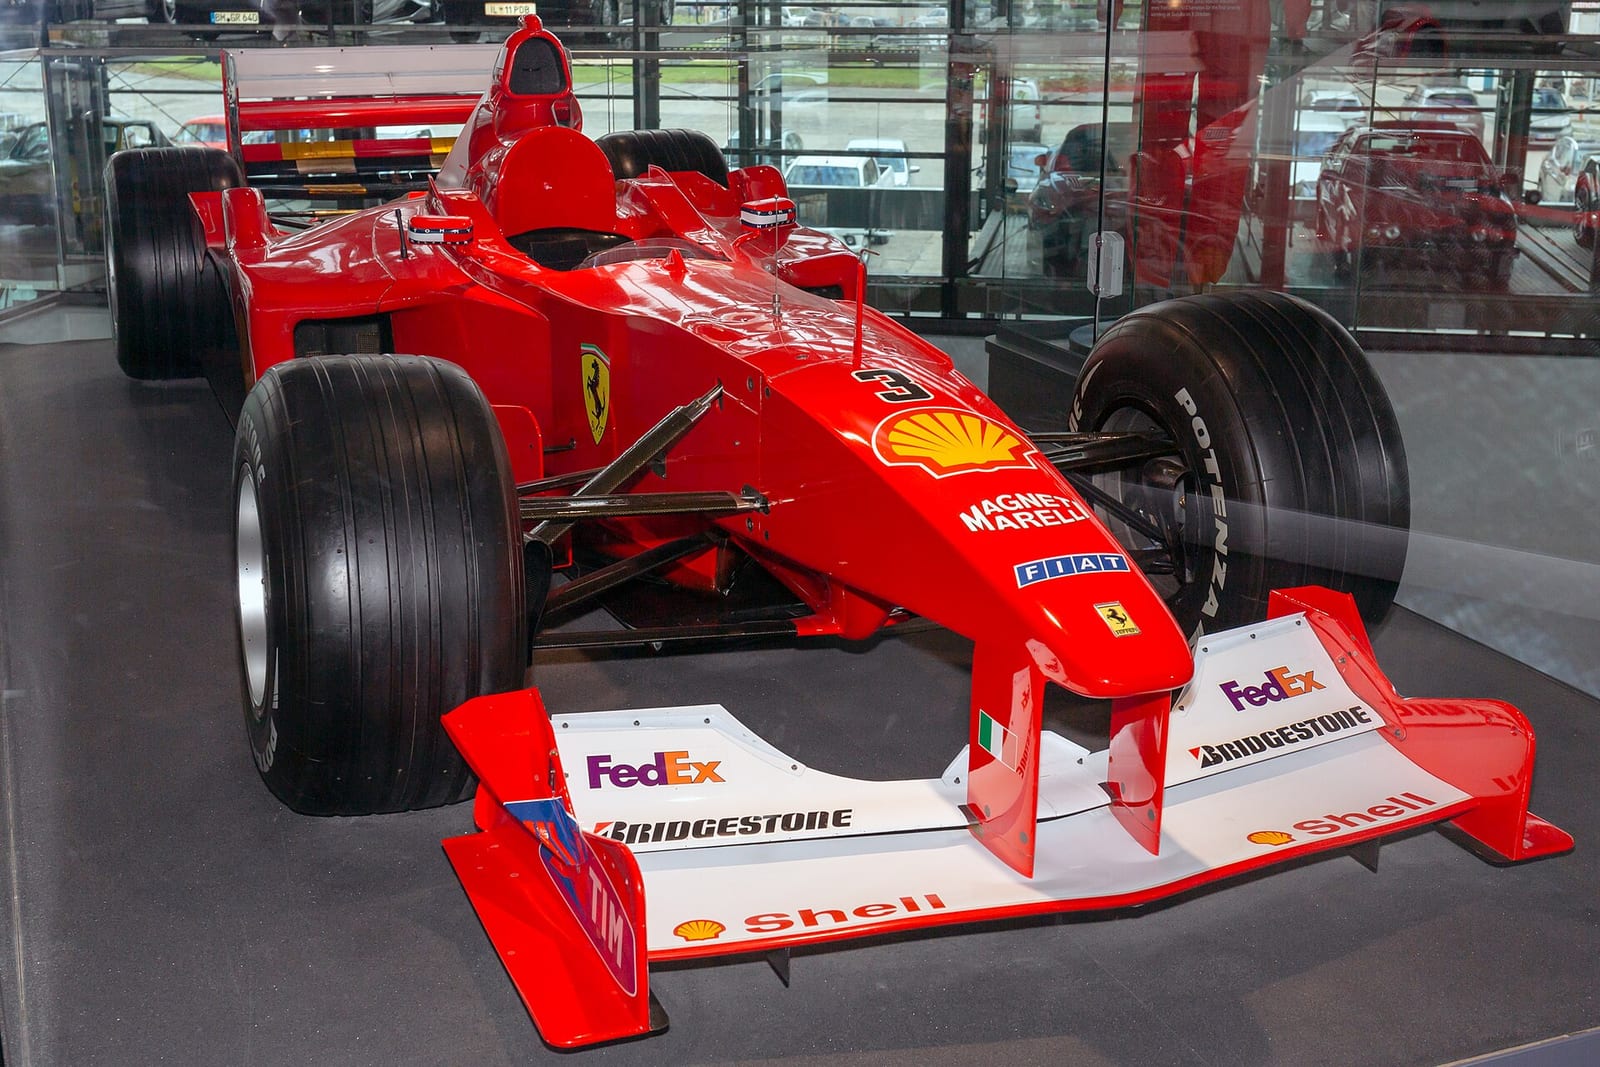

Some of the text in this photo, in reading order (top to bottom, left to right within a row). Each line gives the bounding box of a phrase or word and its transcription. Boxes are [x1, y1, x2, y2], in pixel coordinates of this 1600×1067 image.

[852, 368, 931, 403] 3
[1174, 386, 1228, 618] POTENZA
[1023, 555, 1123, 582] FIAT
[1218, 665, 1327, 712] FedEx
[1196, 705, 1372, 768] BRIDGESTONE
[586, 750, 726, 789] FedEx
[603, 808, 853, 844] BRIDGESTONE
[1292, 792, 1437, 835] Shell
[588, 865, 624, 969] TIM
[744, 893, 946, 933] Shell
